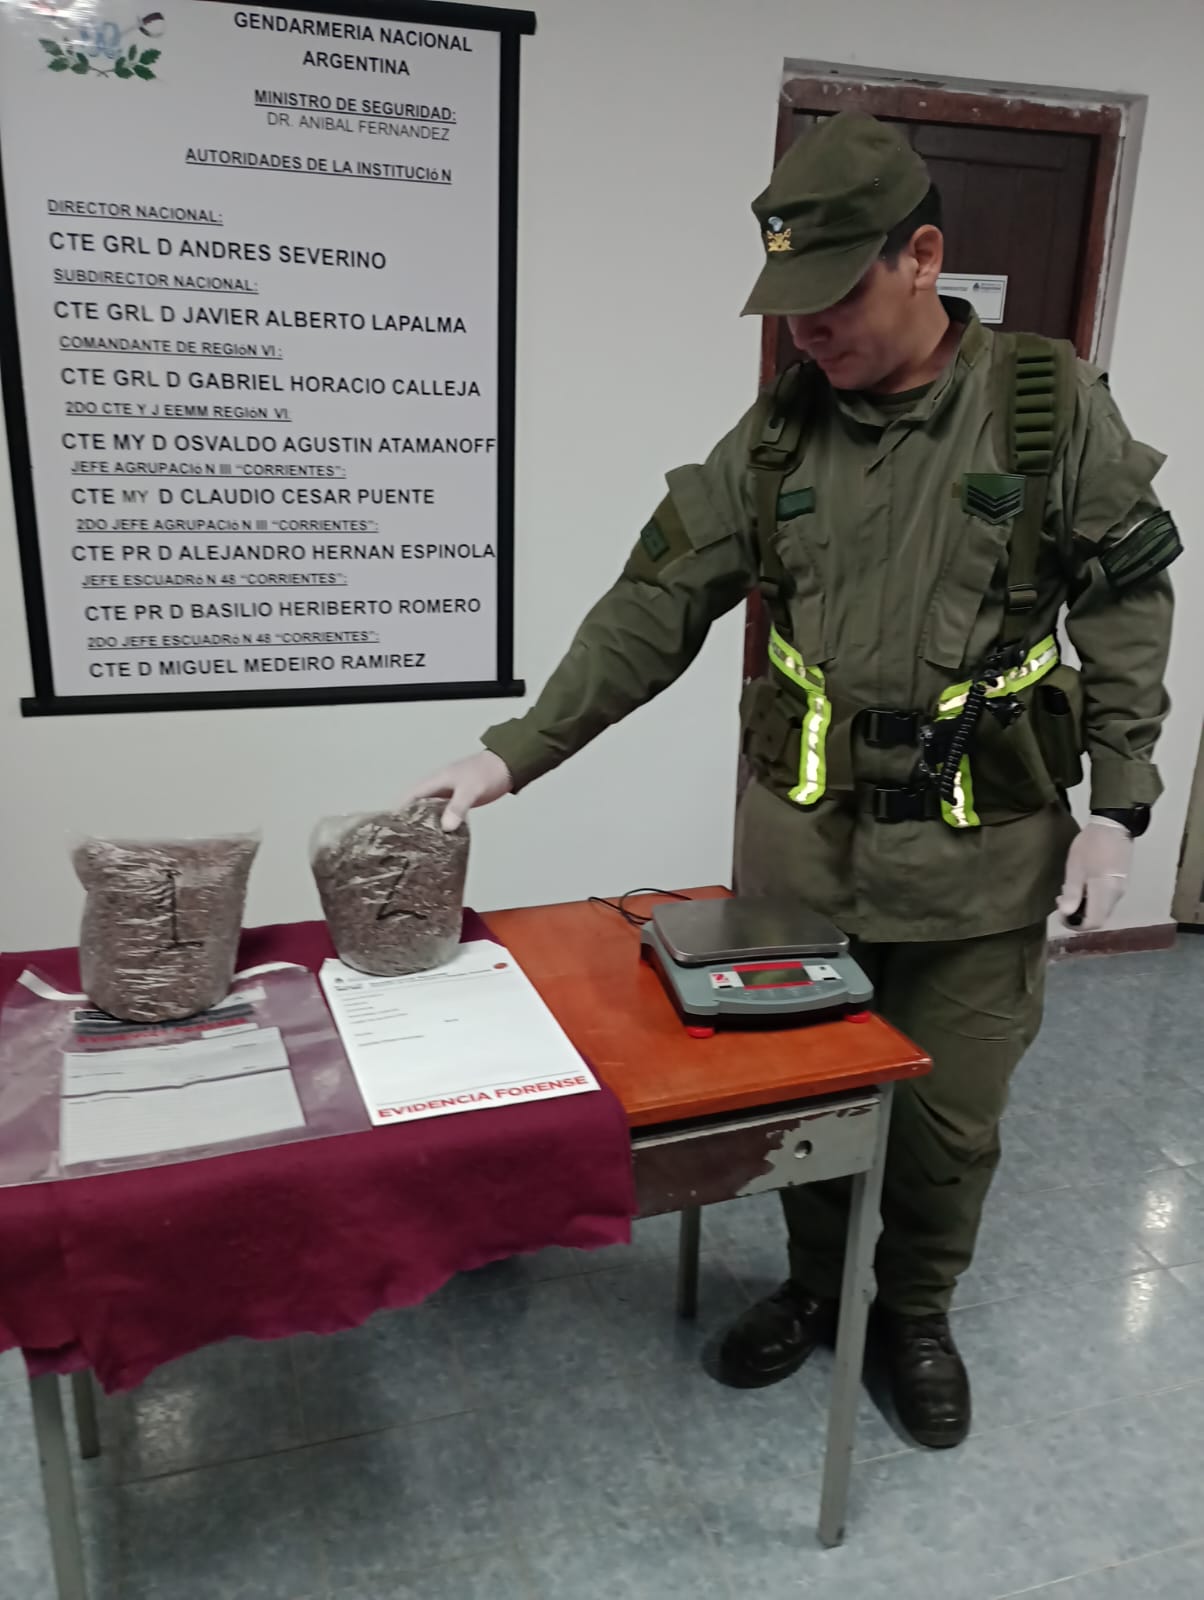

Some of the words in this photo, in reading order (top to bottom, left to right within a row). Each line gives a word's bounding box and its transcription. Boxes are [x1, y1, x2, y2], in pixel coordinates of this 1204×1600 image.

[234, 11, 375, 42] GENDARMERIA
[380, 30, 472, 52] NACIONAL
[302, 51, 410, 76] ARGENTINA
[255, 89, 332, 109] MINISTRO
[335, 97, 357, 111] DE
[361, 99, 456, 121] SEGURIDAD:
[267, 112, 294, 127] DR.
[299, 115, 354, 133] ANIBAL
[359, 119, 450, 141] FERNANDEZ
[186, 148, 302, 170] AUTORIDADES
[307, 157, 327, 171] DE
[332, 159, 353, 173] LA
[48, 200, 132, 216] DIRECTOR
[136, 205, 223, 222] NACIONAL:
[49, 232, 94, 251] CTE
[103, 235, 150, 254] GRL
[158, 238, 173, 254] D
[179, 240, 271, 261] ANDRES
[279, 245, 386, 268] SEVERINO
[54, 269, 169, 286] SUBDIRECTOR
[174, 275, 258, 291] NACIONAL:
[54, 301, 99, 318] CTE
[106, 303, 153, 321] GRL
[161, 306, 175, 322] D
[182, 307, 259, 325] JAVIER
[265, 310, 365, 329] ALBERTO
[371, 314, 467, 332] LAPALMA
[59, 335, 171, 352] COMANDANTE
[176, 340, 197, 353] DE
[61, 368, 105, 384] CTE
[113, 370, 160, 387] GRL
[167, 371, 181, 386] D
[188, 372, 283, 390] GABRIEL
[291, 376, 386, 393] HORACIO
[392, 379, 481, 395] CALLEJA
[66, 402, 98, 414] 2DO
[102, 403, 132, 415] CTE
[137, 404, 146, 415] Y
[150, 404, 159, 416] J
[165, 404, 209, 416] EEMM
[62, 434, 105, 449] CTE
[113, 434, 146, 449] MY
[153, 435, 167, 449] D
[174, 435, 277, 451] OSVALDO
[283, 436, 372, 452] AGUSTIN
[378, 437, 496, 452] ATAMANOFF
[71, 462, 109, 472] JEFE
[71, 489, 115, 503] CTE
[122, 490, 148, 502] MY
[159, 489, 173, 502] D
[181, 488, 275, 503] CLAUDIO
[282, 488, 351, 503] CESAR
[358, 489, 434, 503] PUENTE
[76, 519, 108, 531] 2DO
[111, 519, 150, 531] JEFE
[71, 546, 115, 560] CTE
[122, 546, 152, 559] PR
[159, 545, 173, 559] D
[179, 545, 305, 560] ALEJANDRO
[312, 545, 395, 558] HERNAN
[401, 543, 495, 557] ESPINOLA
[82, 575, 120, 585] JEFE
[221, 574, 235, 584] 48
[85, 605, 127, 620] CTE
[135, 605, 164, 618] PR
[170, 604, 184, 617] D
[191, 602, 273, 617] BASILIO
[279, 600, 393, 615] HERIBERTO
[400, 598, 481, 613] ROMERO
[88, 636, 117, 648] 2DO
[121, 635, 159, 647] JEFE
[257, 633, 271, 643] 48
[89, 662, 131, 676] CTE
[138, 661, 152, 674] D
[159, 659, 239, 674] MIGUEL
[244, 657, 335, 671] MEDEIRO
[341, 653, 426, 668] RAMIREZ
[377, 1092, 492, 1119] EVIDENCIA
[494, 1075, 590, 1099] FORENSE
